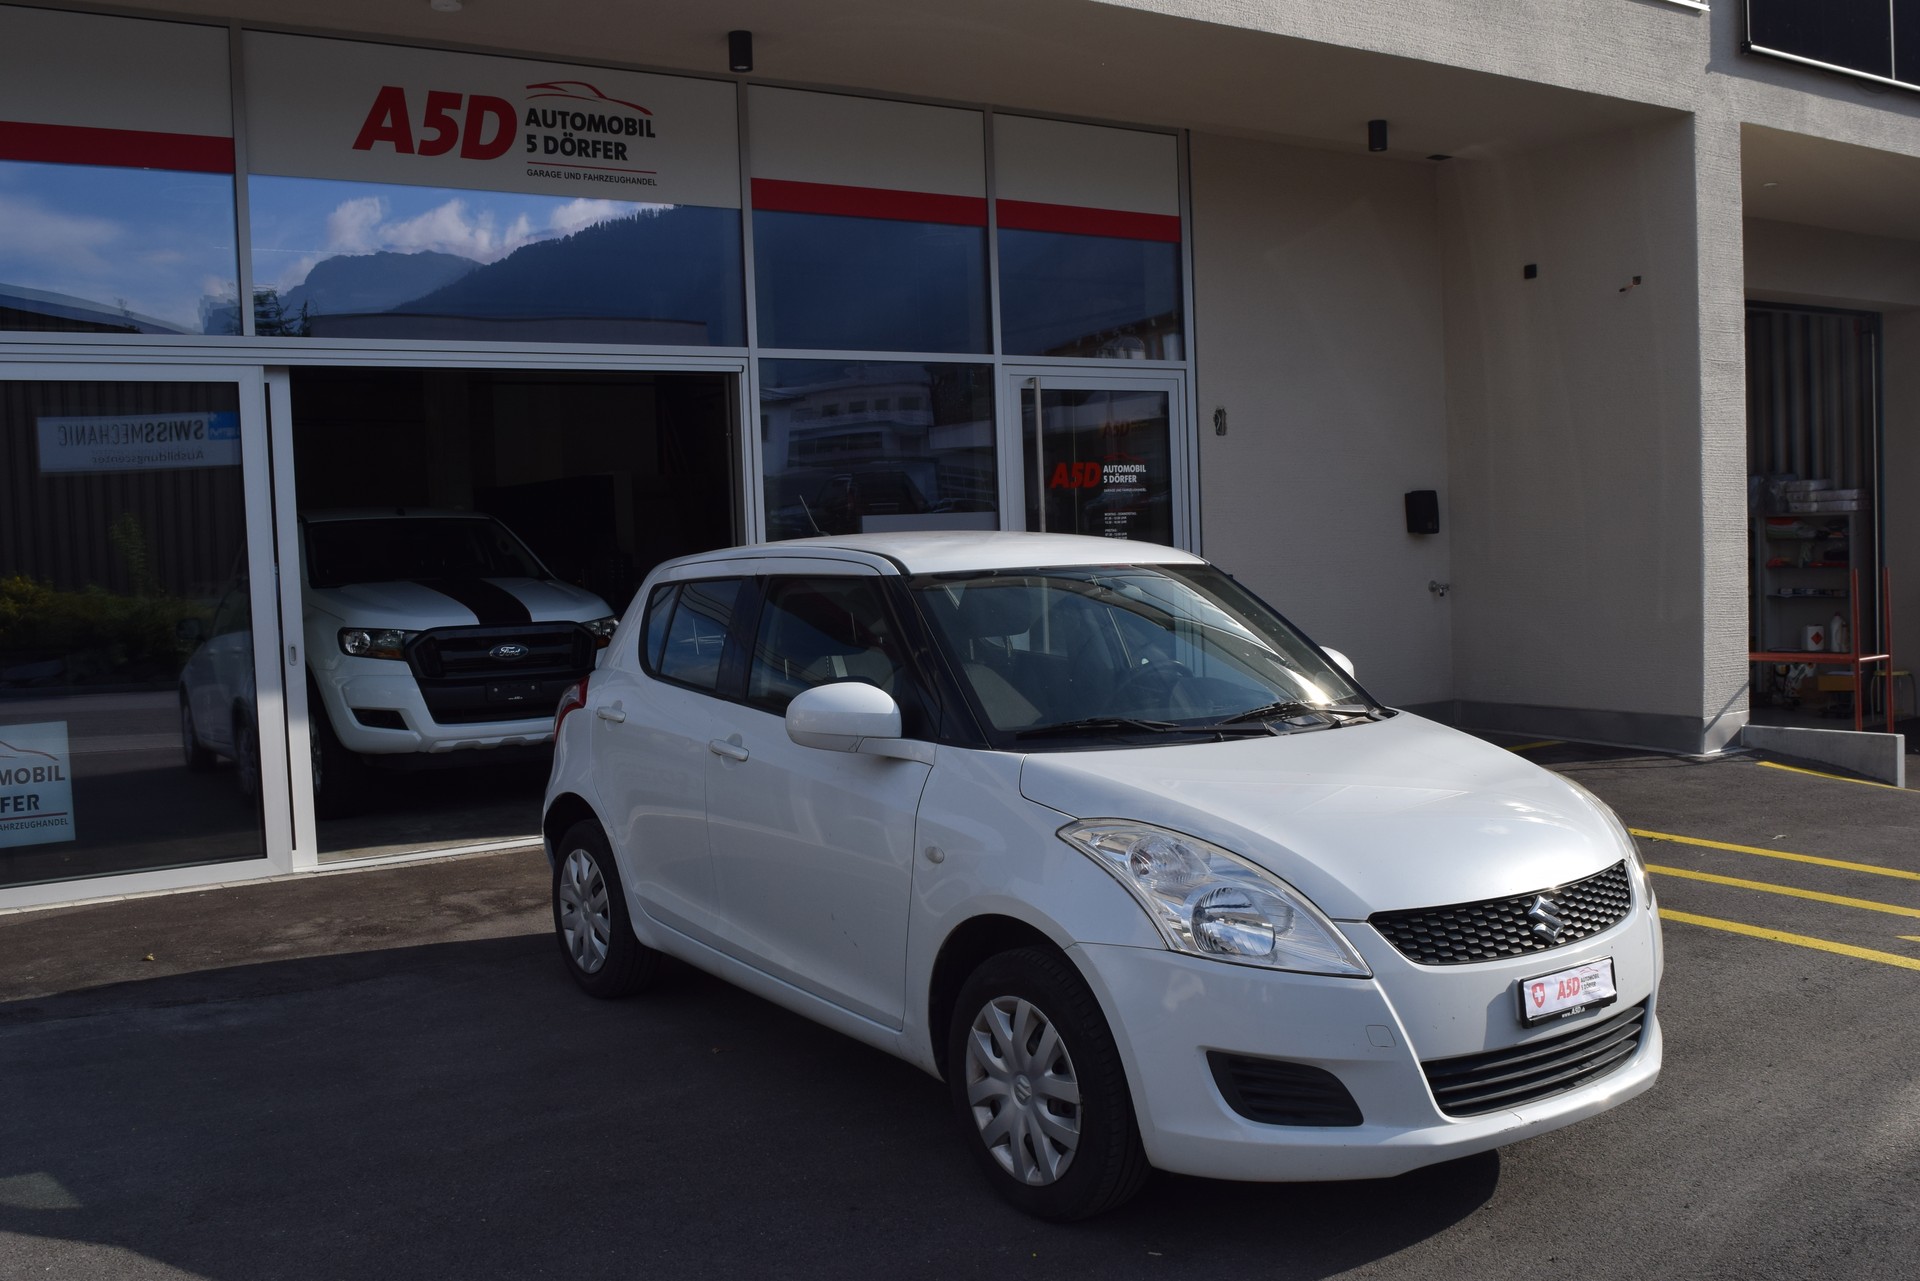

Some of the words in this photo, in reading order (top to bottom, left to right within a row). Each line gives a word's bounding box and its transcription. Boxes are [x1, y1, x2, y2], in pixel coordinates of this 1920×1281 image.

[352, 85, 517, 160] A5D
[525, 108, 656, 138] AUTOMOBIL
[526, 134, 538, 153] 5
[543, 131, 629, 161] DÖRFER
[526, 169, 562, 179] GARAGE
[564, 171, 582, 181] UND
[583, 172, 658, 186] FAHRZEUGHANDEL
[1051, 462, 1101, 488] A5D
[1103, 464, 1147, 473] AUTOMOBIL
[1109, 473, 1137, 483] DÖRFER
[499, 646, 521, 656] Ford
[0, 794, 39, 813] FER
[1557, 976, 1580, 1000] A5D
